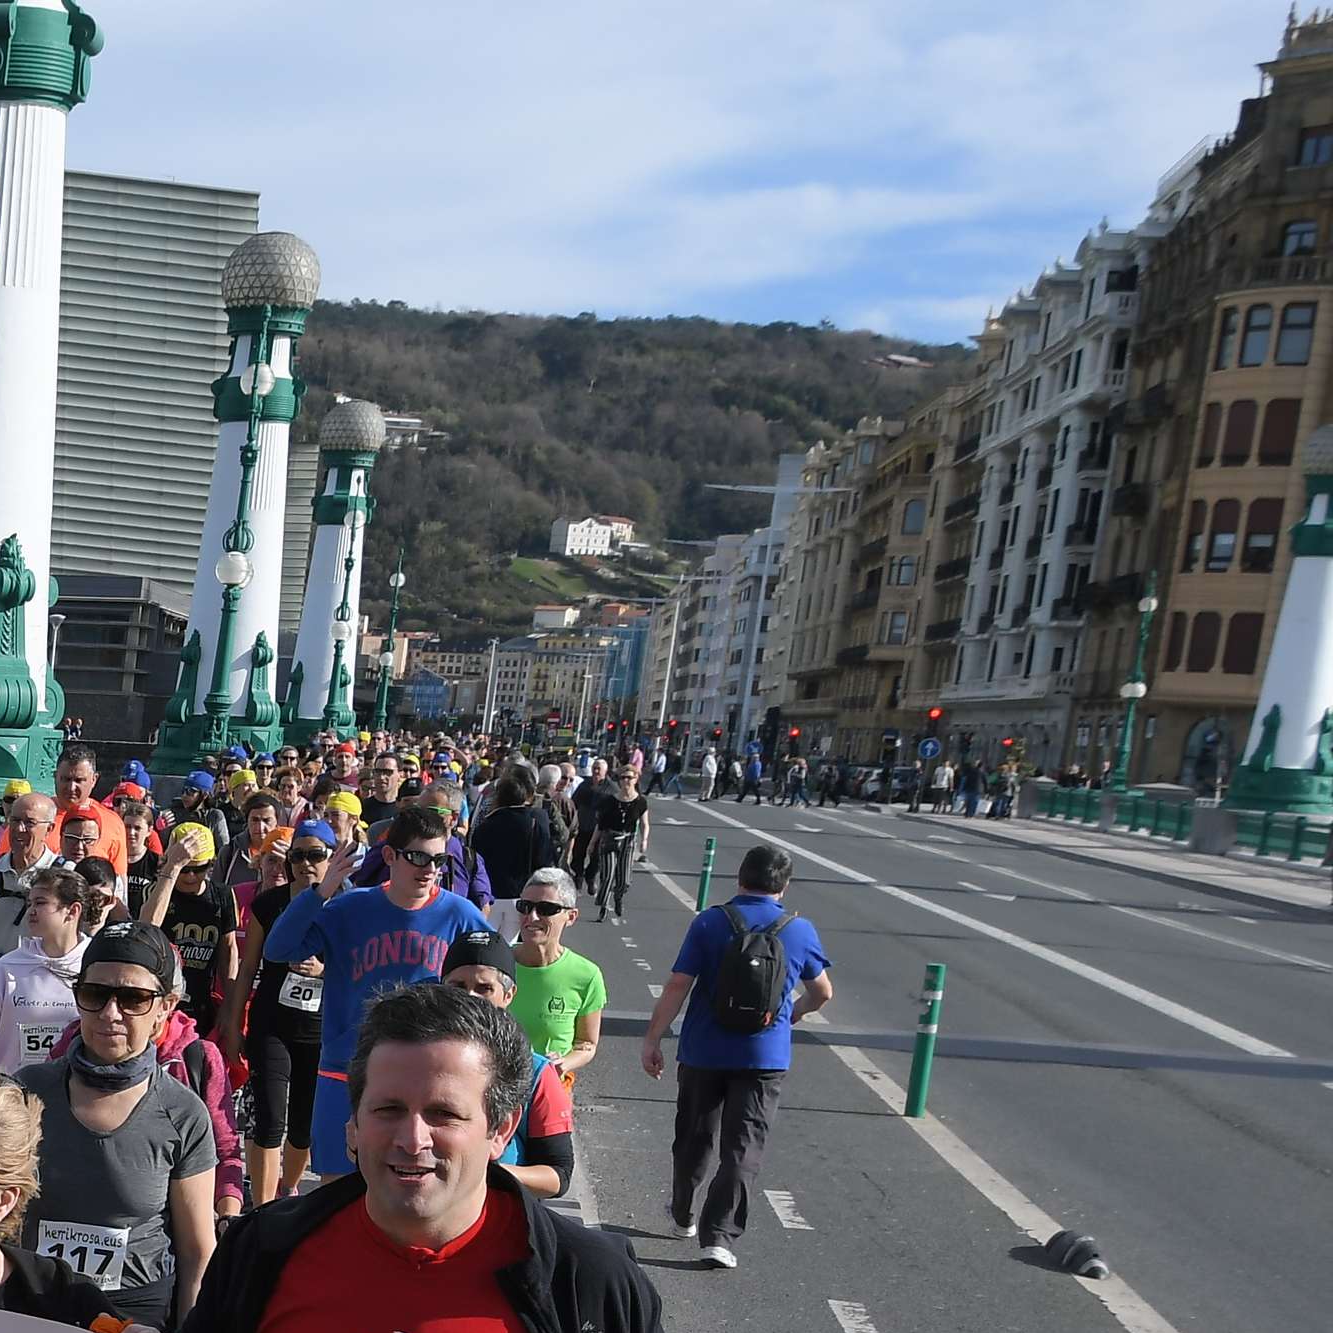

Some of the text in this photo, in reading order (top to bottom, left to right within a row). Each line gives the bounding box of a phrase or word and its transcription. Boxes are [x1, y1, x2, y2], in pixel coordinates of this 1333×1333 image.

[289, 985, 313, 1001] 20
[26, 1035, 54, 1051] 54
[44, 1225, 123, 1248] herrikrosa.eus
[47, 1243, 115, 1275] 117
